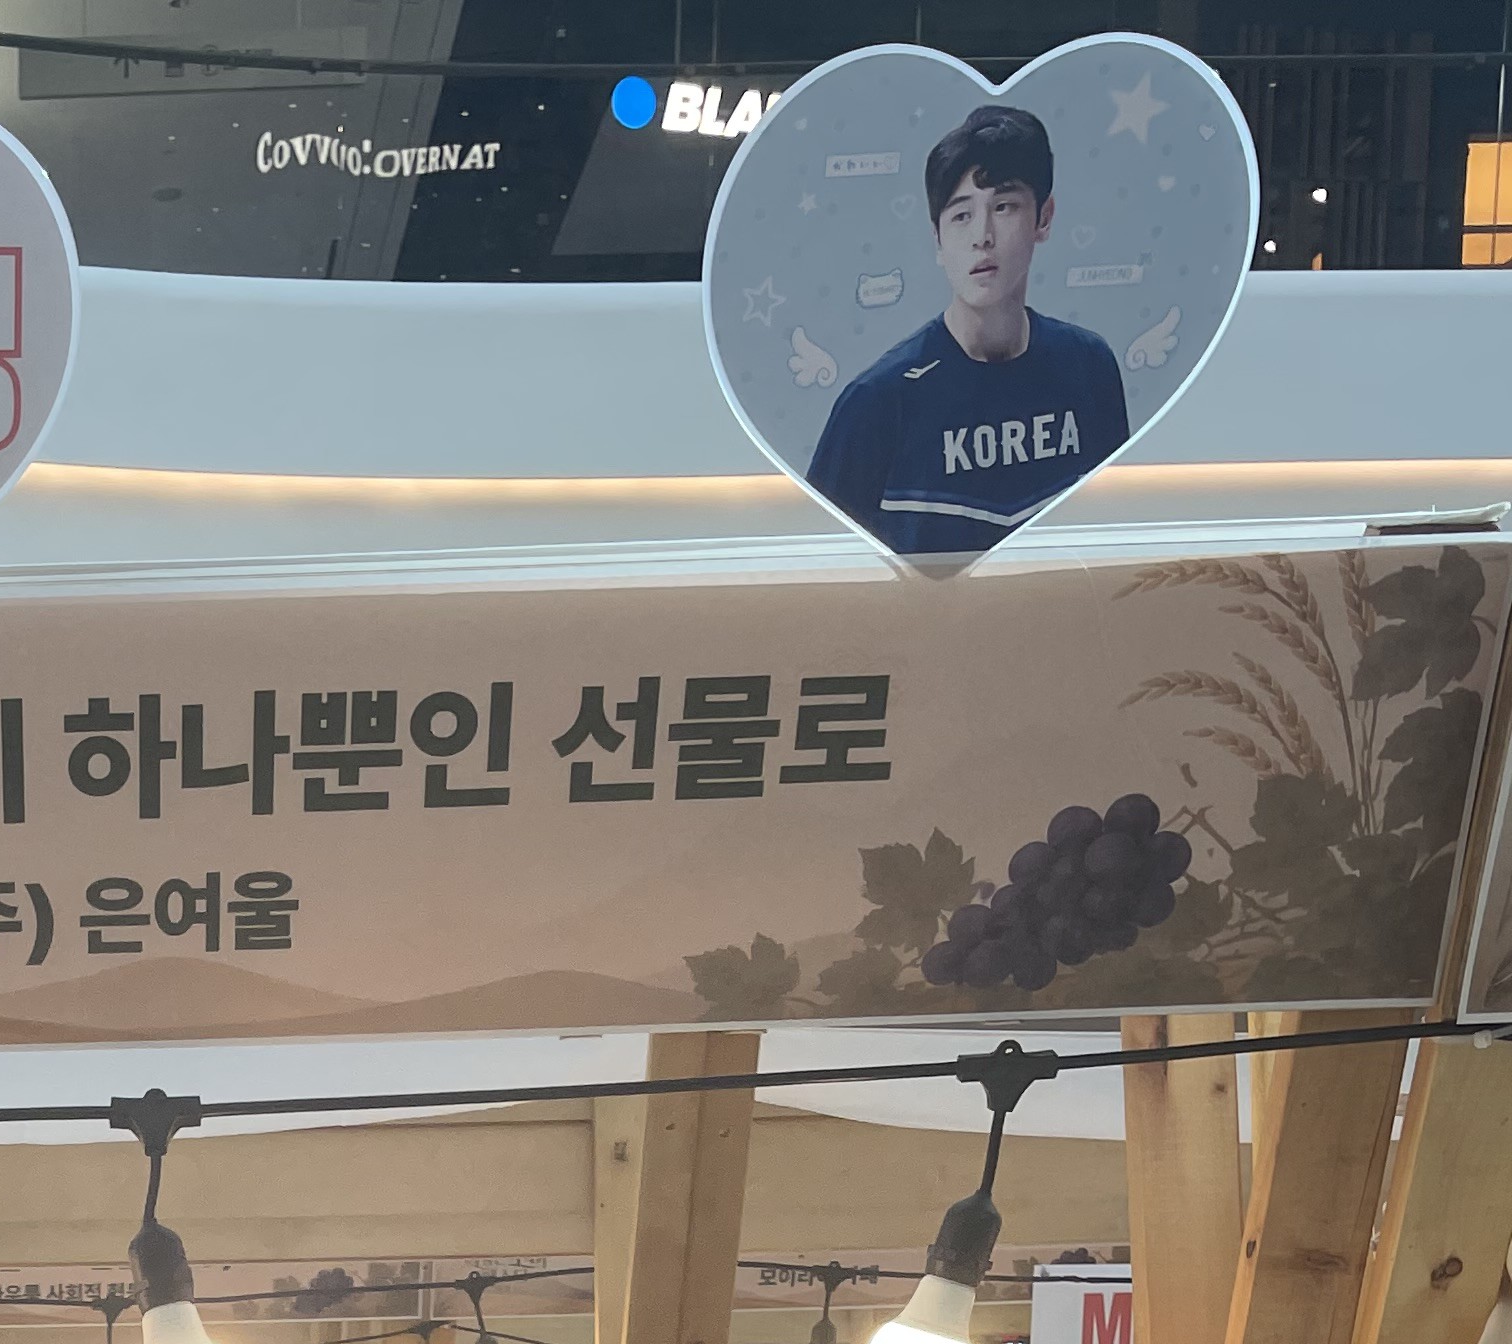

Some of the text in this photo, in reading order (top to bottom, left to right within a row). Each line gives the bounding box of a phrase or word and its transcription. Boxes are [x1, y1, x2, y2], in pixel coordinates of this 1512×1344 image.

[661, 81, 781, 138] BLA
[942, 411, 1080, 475] KOREA
[64, 682, 513, 819] 하나뿐인
[552, 674, 892, 804] 선물로
[80, 871, 299, 954] 은여울
